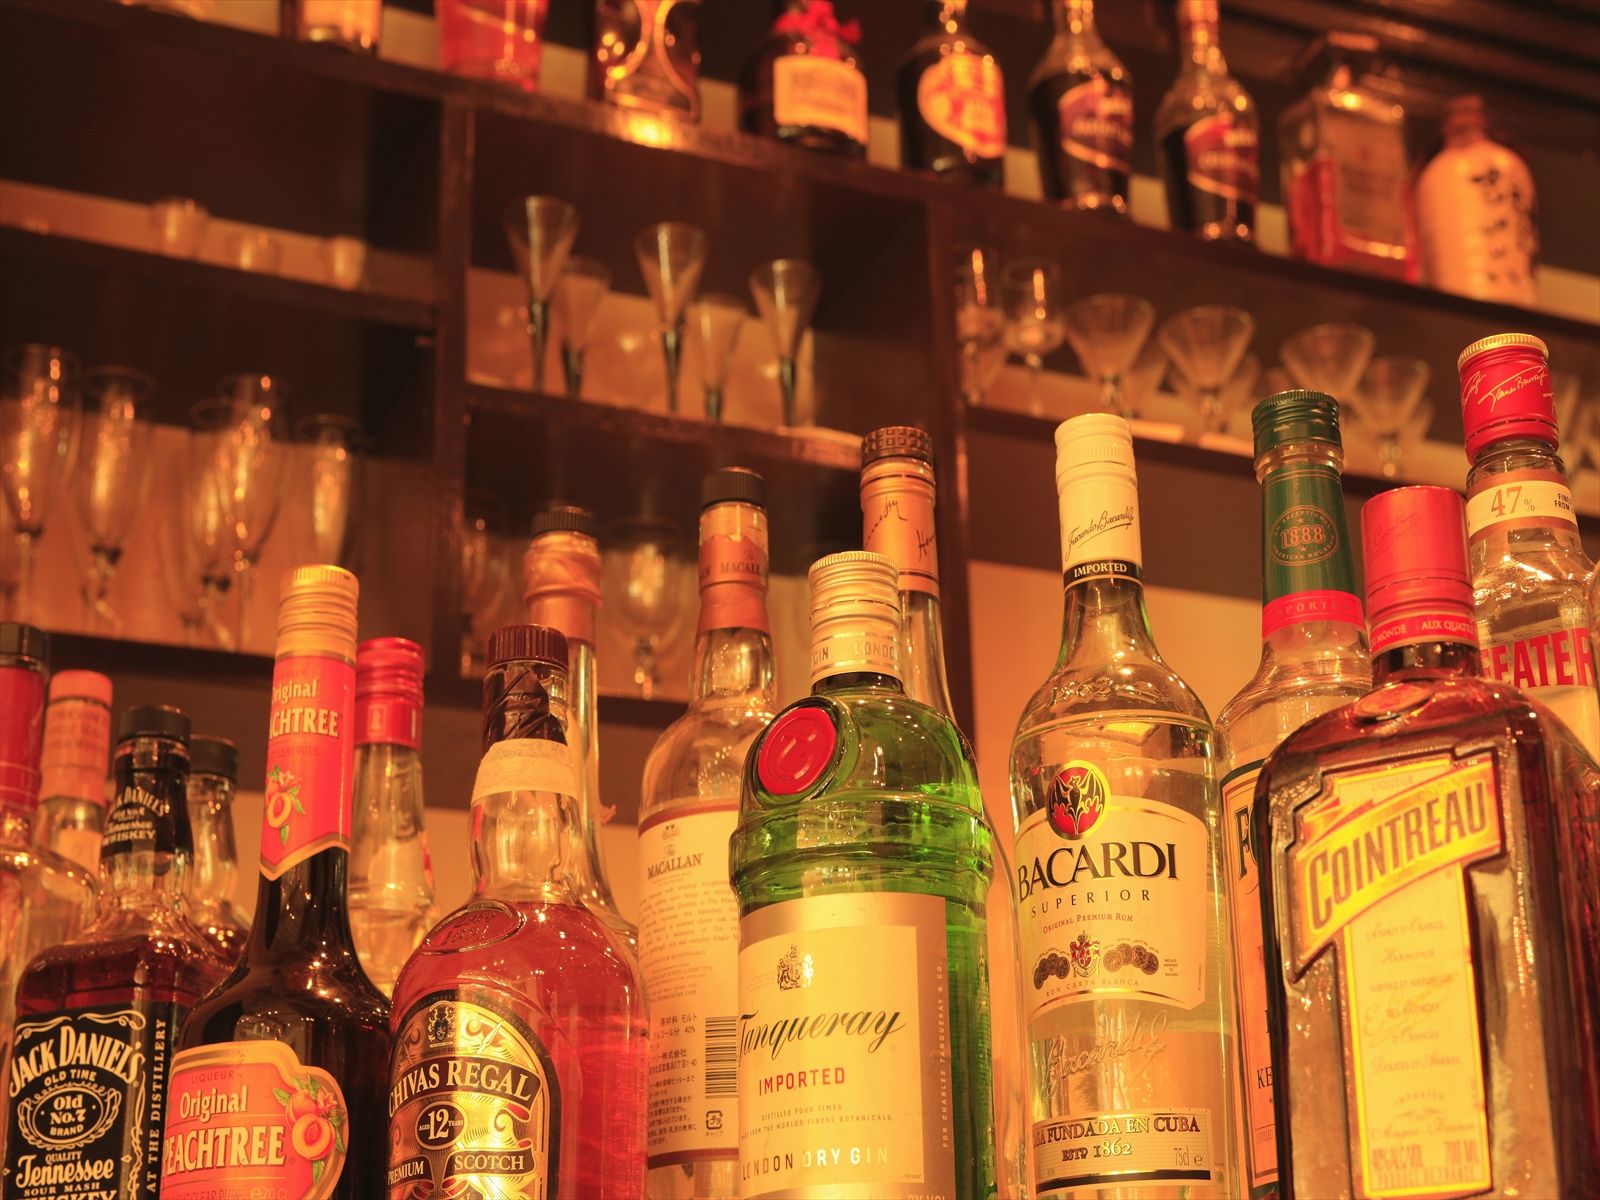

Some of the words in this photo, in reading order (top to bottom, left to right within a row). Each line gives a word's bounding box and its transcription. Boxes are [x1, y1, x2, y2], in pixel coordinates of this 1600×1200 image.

[1490, 486, 1522, 518] 47
[1281, 524, 1325, 549] 1888
[1073, 562, 1128, 578] IMPORTED
[1420, 619, 1443, 631] AUX
[813, 646, 829, 665] GIN
[647, 853, 702, 880] MACALLAN
[1308, 781, 1488, 931] COINTREAU
[1017, 841, 1179, 904] BACARDI
[1031, 888, 1150, 918] SUPERIOR
[1065, 979, 1095, 990] CARTA
[1101, 977, 1140, 986] BLANCA
[738, 1009, 907, 1067] Tanqueray
[9, 1038, 58, 1098] JACK
[59, 1025, 146, 1085] DANIEL'S
[150, 1018, 166, 1122] DISTILLERY
[44, 1071, 67, 1087] OLD
[69, 1068, 98, 1082] TIME
[388, 1062, 440, 1118] CHIVAS
[445, 1060, 532, 1101] REGAL
[758, 1067, 845, 1096] IMPORTED
[53, 1094, 84, 1111] Old
[180, 1084, 249, 1123] Original
[50, 1124, 84, 1137] BRAND
[428, 1108, 450, 1140] 12
[1048, 1119, 1121, 1143] FUNDADA
[1125, 1117, 1150, 1134] EN
[1153, 1116, 1200, 1133] CUBA
[45, 1150, 83, 1164] QUALITY
[148, 1127, 161, 1164] THE
[1093, 1138, 1132, 1158] 1862
[15, 1154, 115, 1189] Tennessee
[387, 1160, 425, 1186] PREMIUM
[454, 1154, 525, 1170] SCOTCH
[742, 1153, 794, 1181] LONDON
[801, 1147, 841, 1168] DRY
[850, 1146, 888, 1165] GIN
[23, 1184, 57, 1198] SOUR
[64, 1181, 100, 1193] MASH
[146, 1171, 158, 1193] AT
